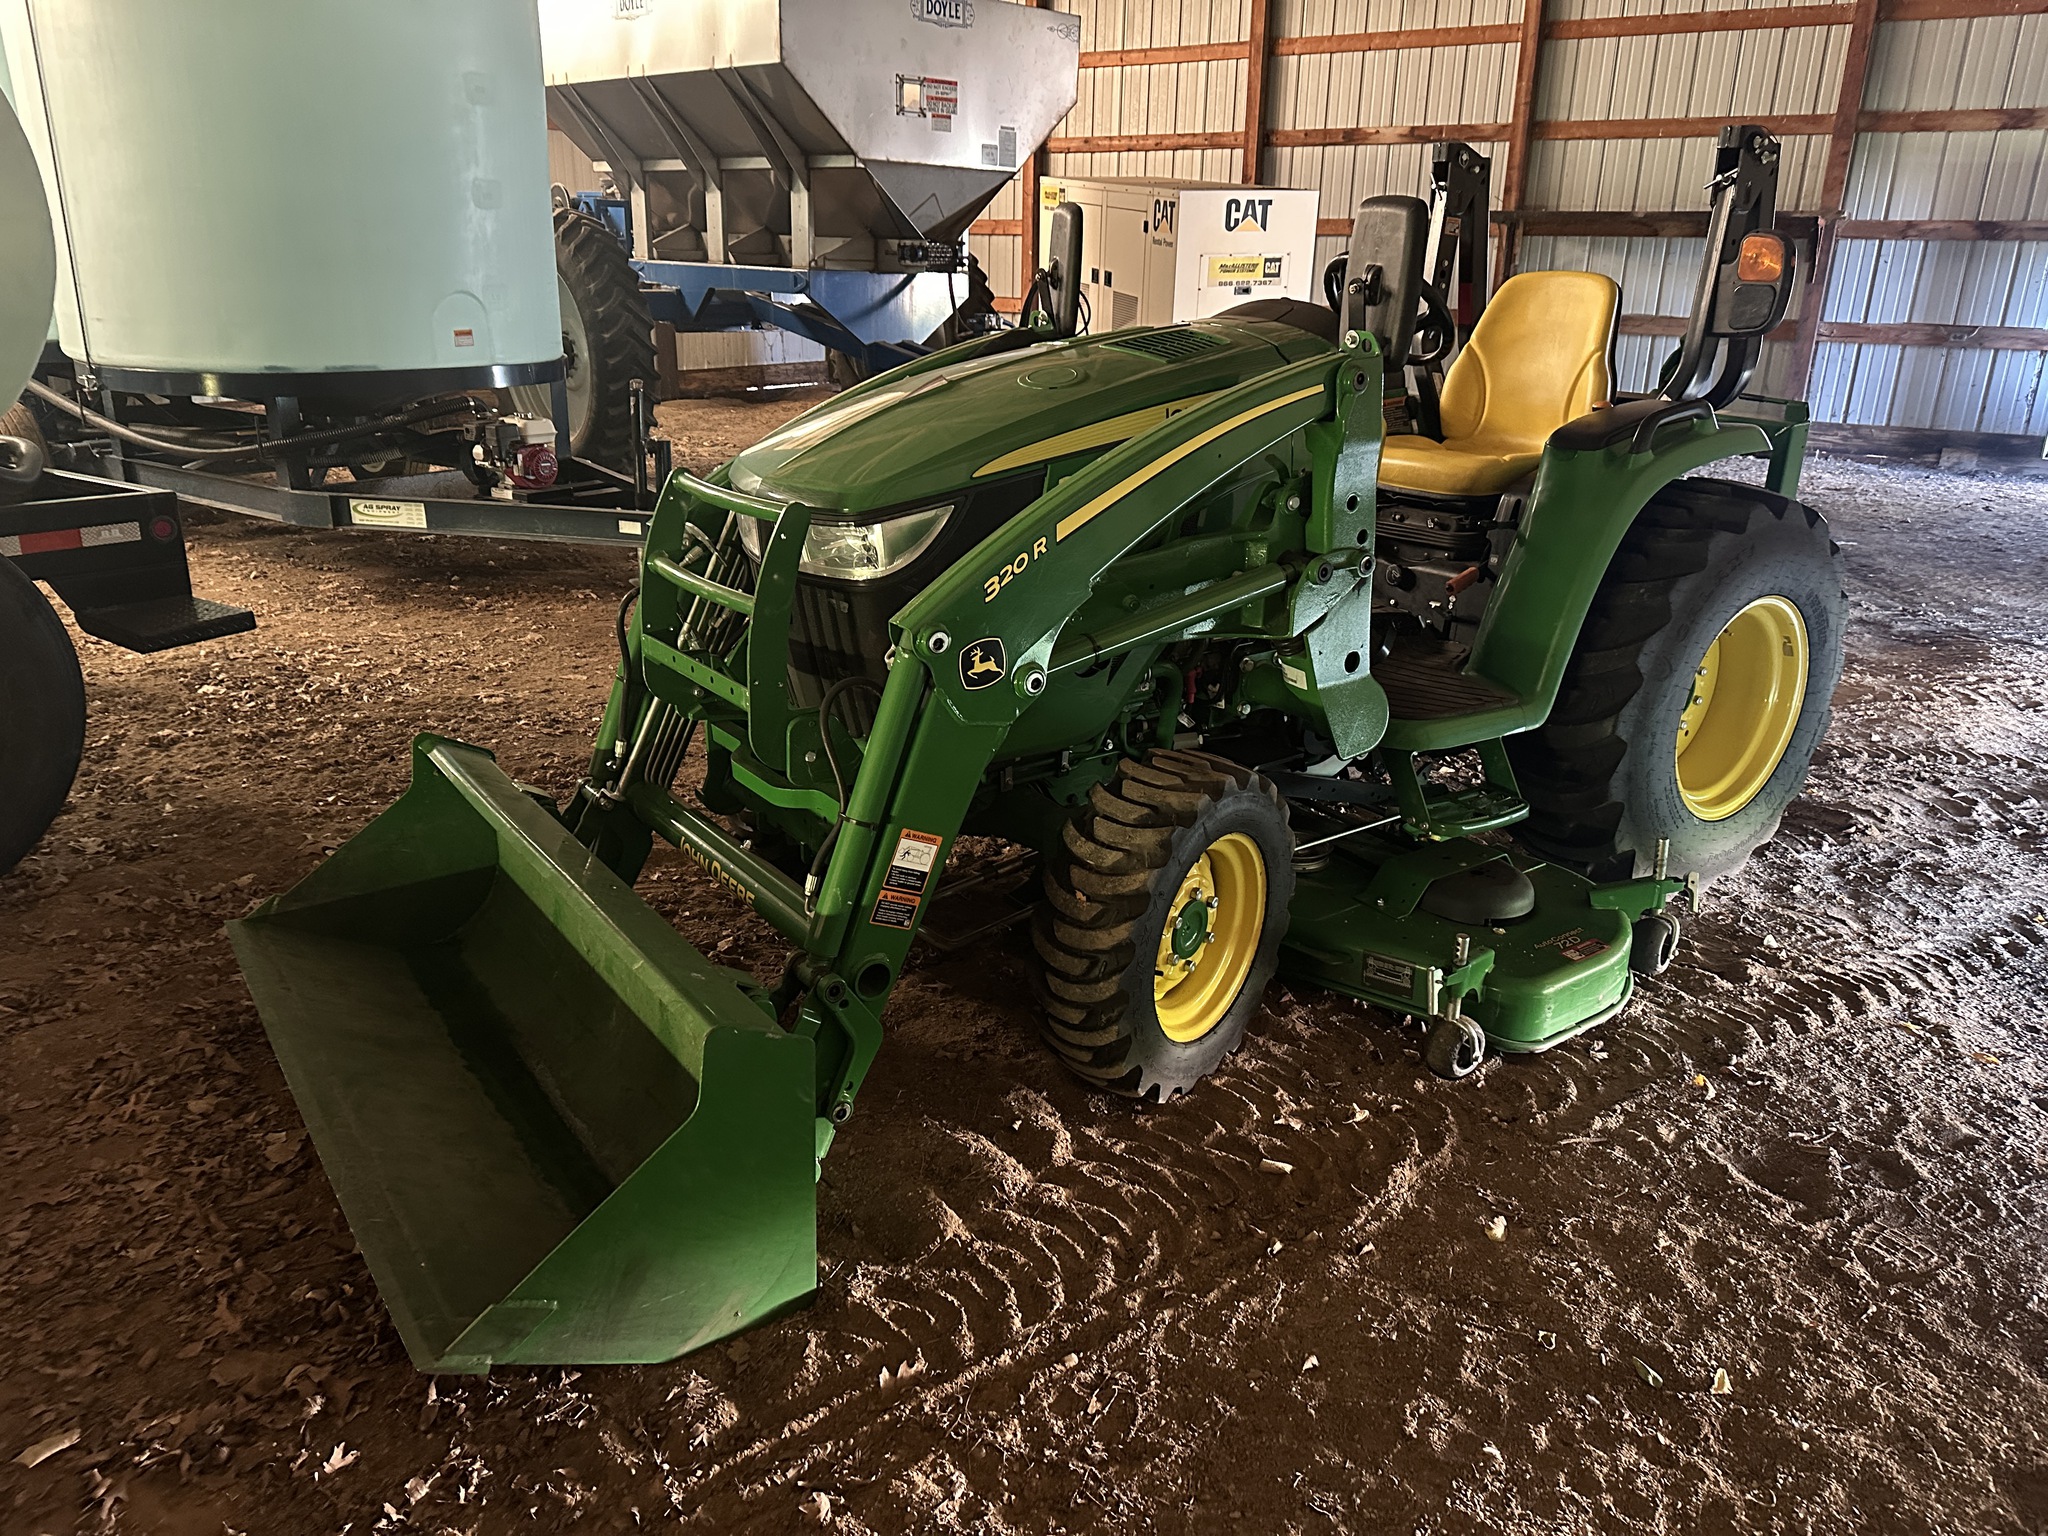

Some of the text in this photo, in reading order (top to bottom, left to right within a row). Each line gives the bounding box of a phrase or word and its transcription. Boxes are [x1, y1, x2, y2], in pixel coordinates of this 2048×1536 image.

[926, 0, 961, 19] DOYLE
[1153, 198, 1176, 235] CAT
[1224, 198, 1273, 232] CAT
[1264, 261, 1281, 274] CAT
[983, 536, 1048, 603] 320 R
[911, 833, 938, 844] WARNING
[680, 836, 756, 908] JOHN DEERE
[890, 894, 916, 904] WARNING
[1533, 927, 1585, 949] AutoConnect
[1553, 936, 1581, 950] 72D
